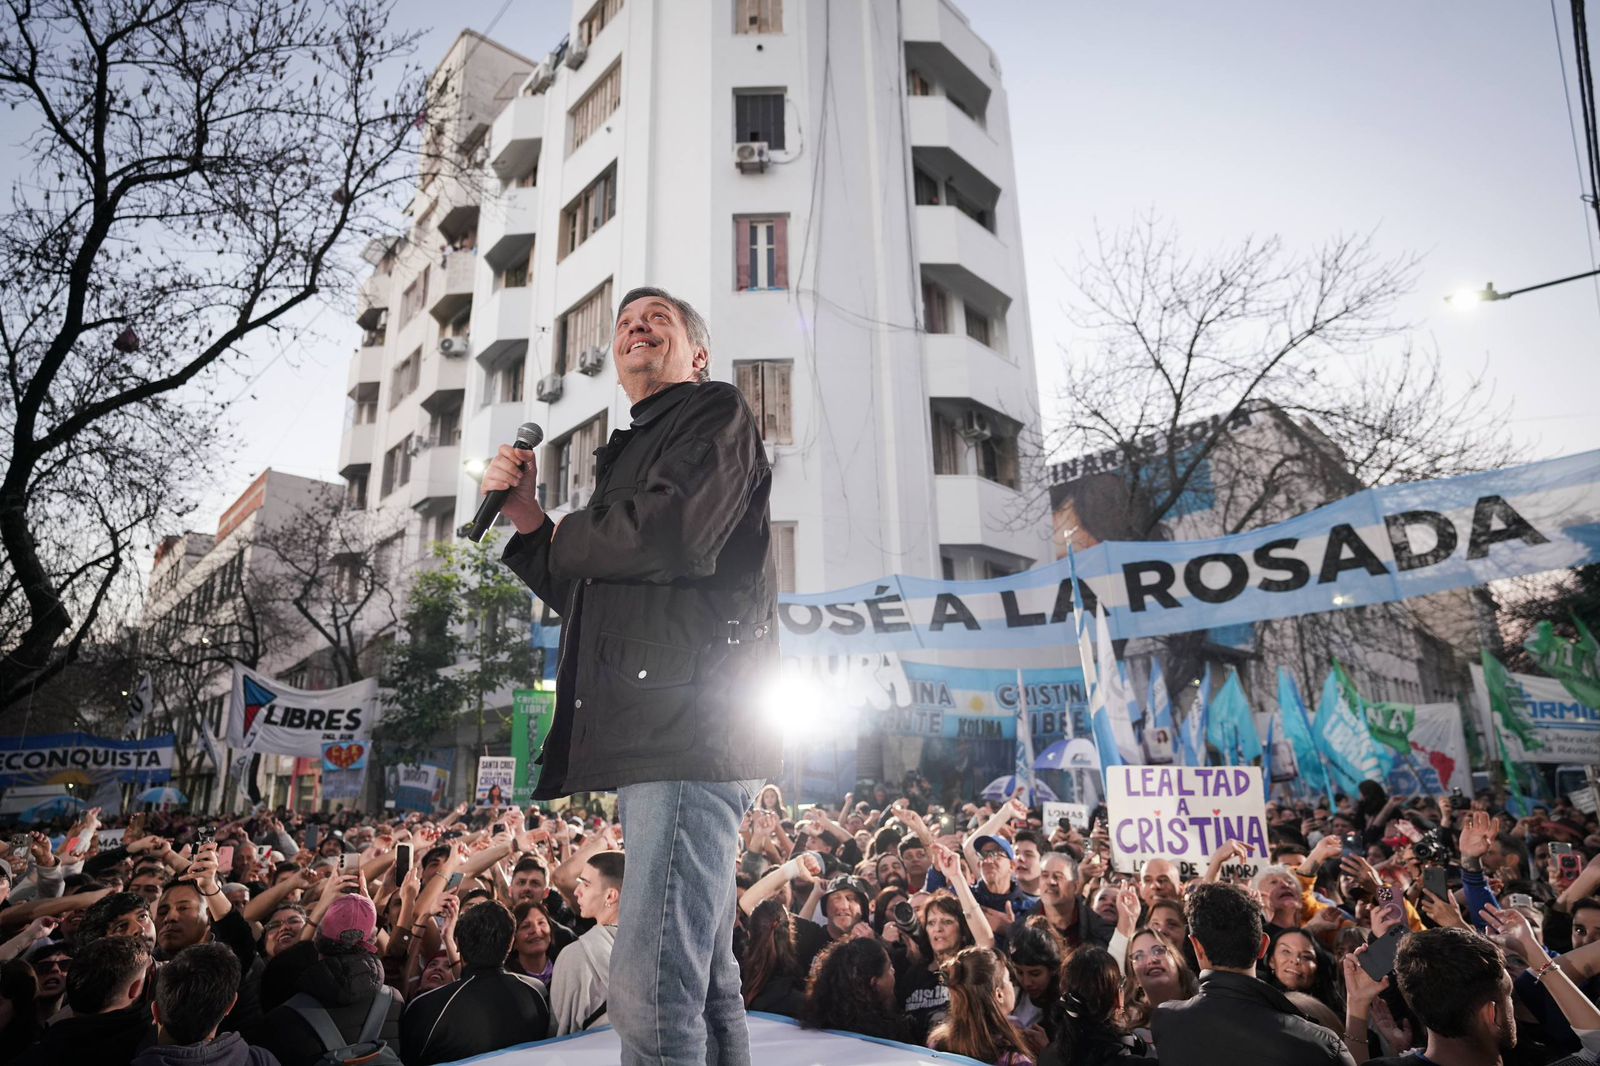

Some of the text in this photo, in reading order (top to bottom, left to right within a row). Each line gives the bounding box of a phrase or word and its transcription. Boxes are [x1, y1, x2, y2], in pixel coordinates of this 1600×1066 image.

[929, 592, 982, 632] A
[999, 577, 1110, 628] LA
[1122, 494, 1551, 613] ROSADA
[998, 683, 1087, 706] CRISTIN
[264, 704, 362, 731] LIBRES
[520, 704, 547, 713] LIBRE
[481, 761, 514, 769] SANTA CRUZ
[480, 777, 512, 785] CRISTINA
[1125, 768, 1250, 797] LEALTAD
[1048, 809, 1083, 819] LOMAS
[1176, 798, 1190, 816] A
[1116, 812, 1269, 858] CRISTINA
[1180, 862, 1259, 878] DE MORA
